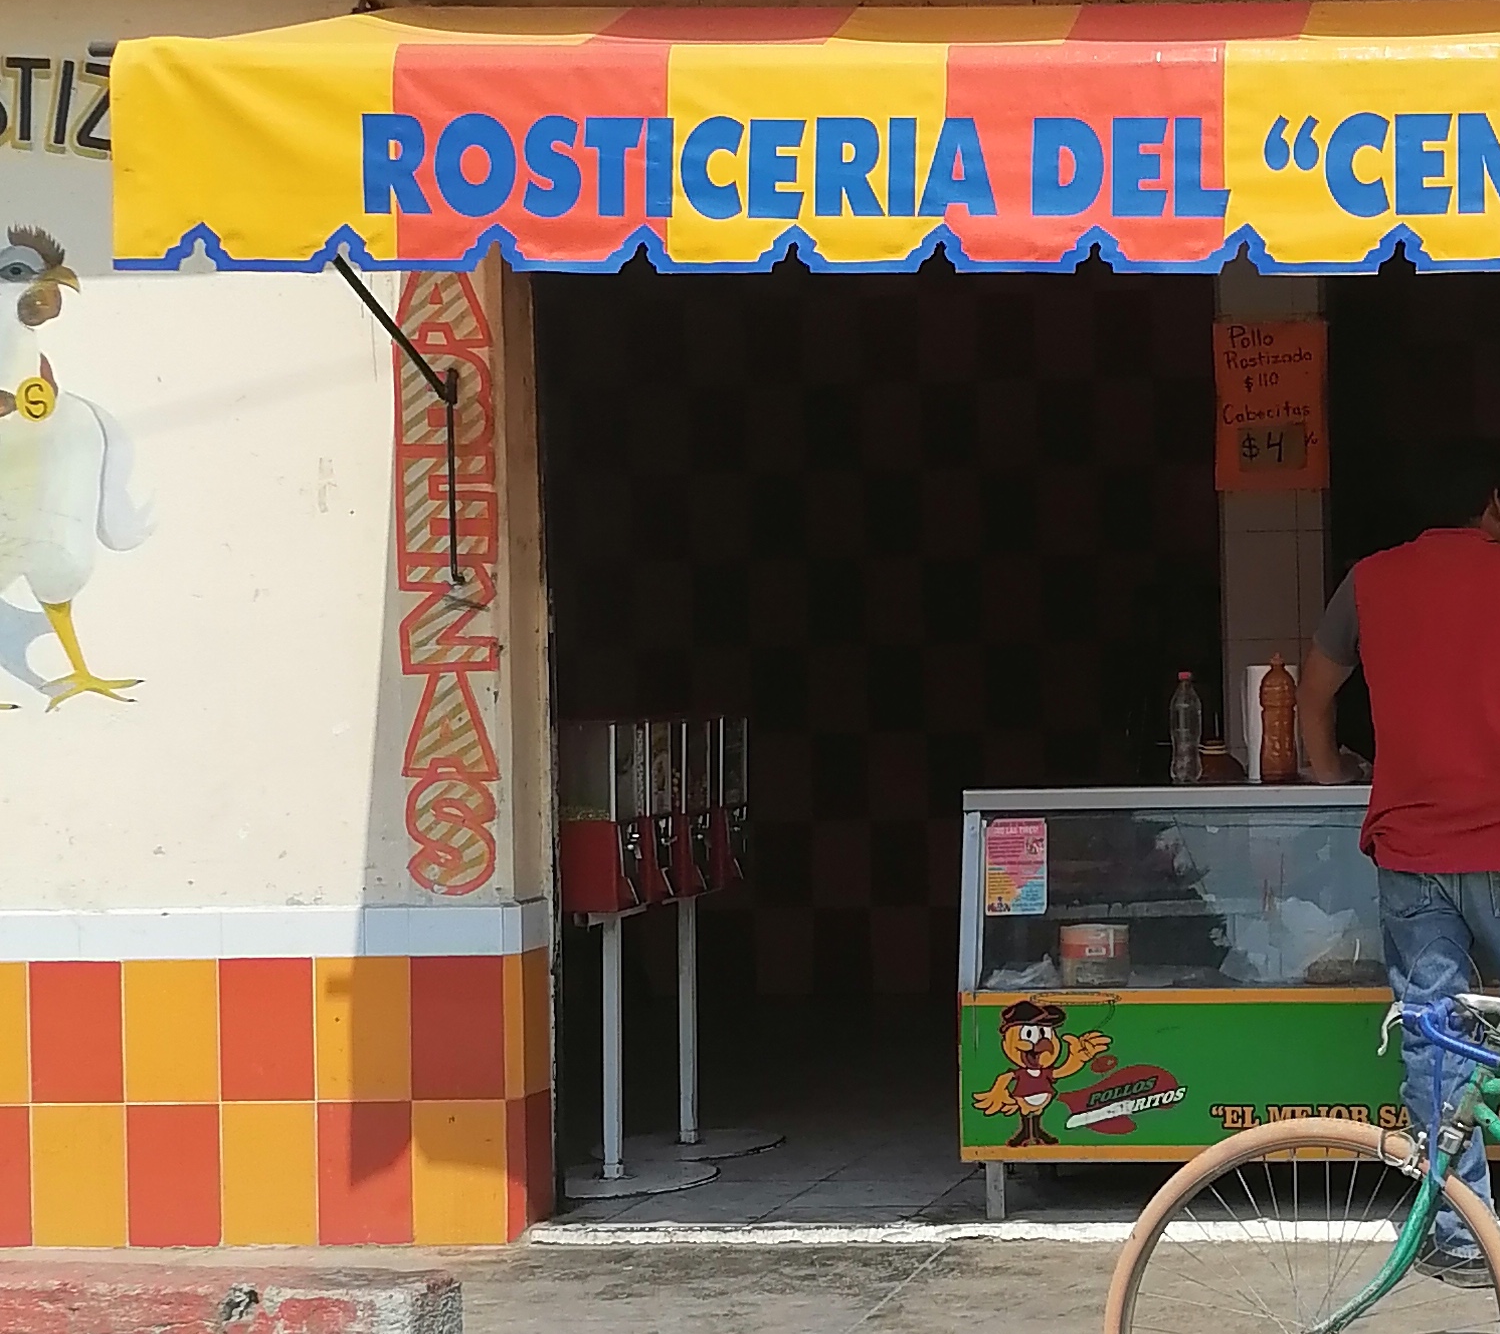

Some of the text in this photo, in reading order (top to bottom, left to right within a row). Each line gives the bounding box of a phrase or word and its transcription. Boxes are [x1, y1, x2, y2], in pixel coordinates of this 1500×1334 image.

[361, 112, 997, 219] ROSTICERIA
[1032, 116, 1231, 218] DEL
[1227, 325, 1275, 349] Pollo
[1222, 401, 1311, 425] Cabecitas
[1088, 1076, 1157, 1107] POLLOS
